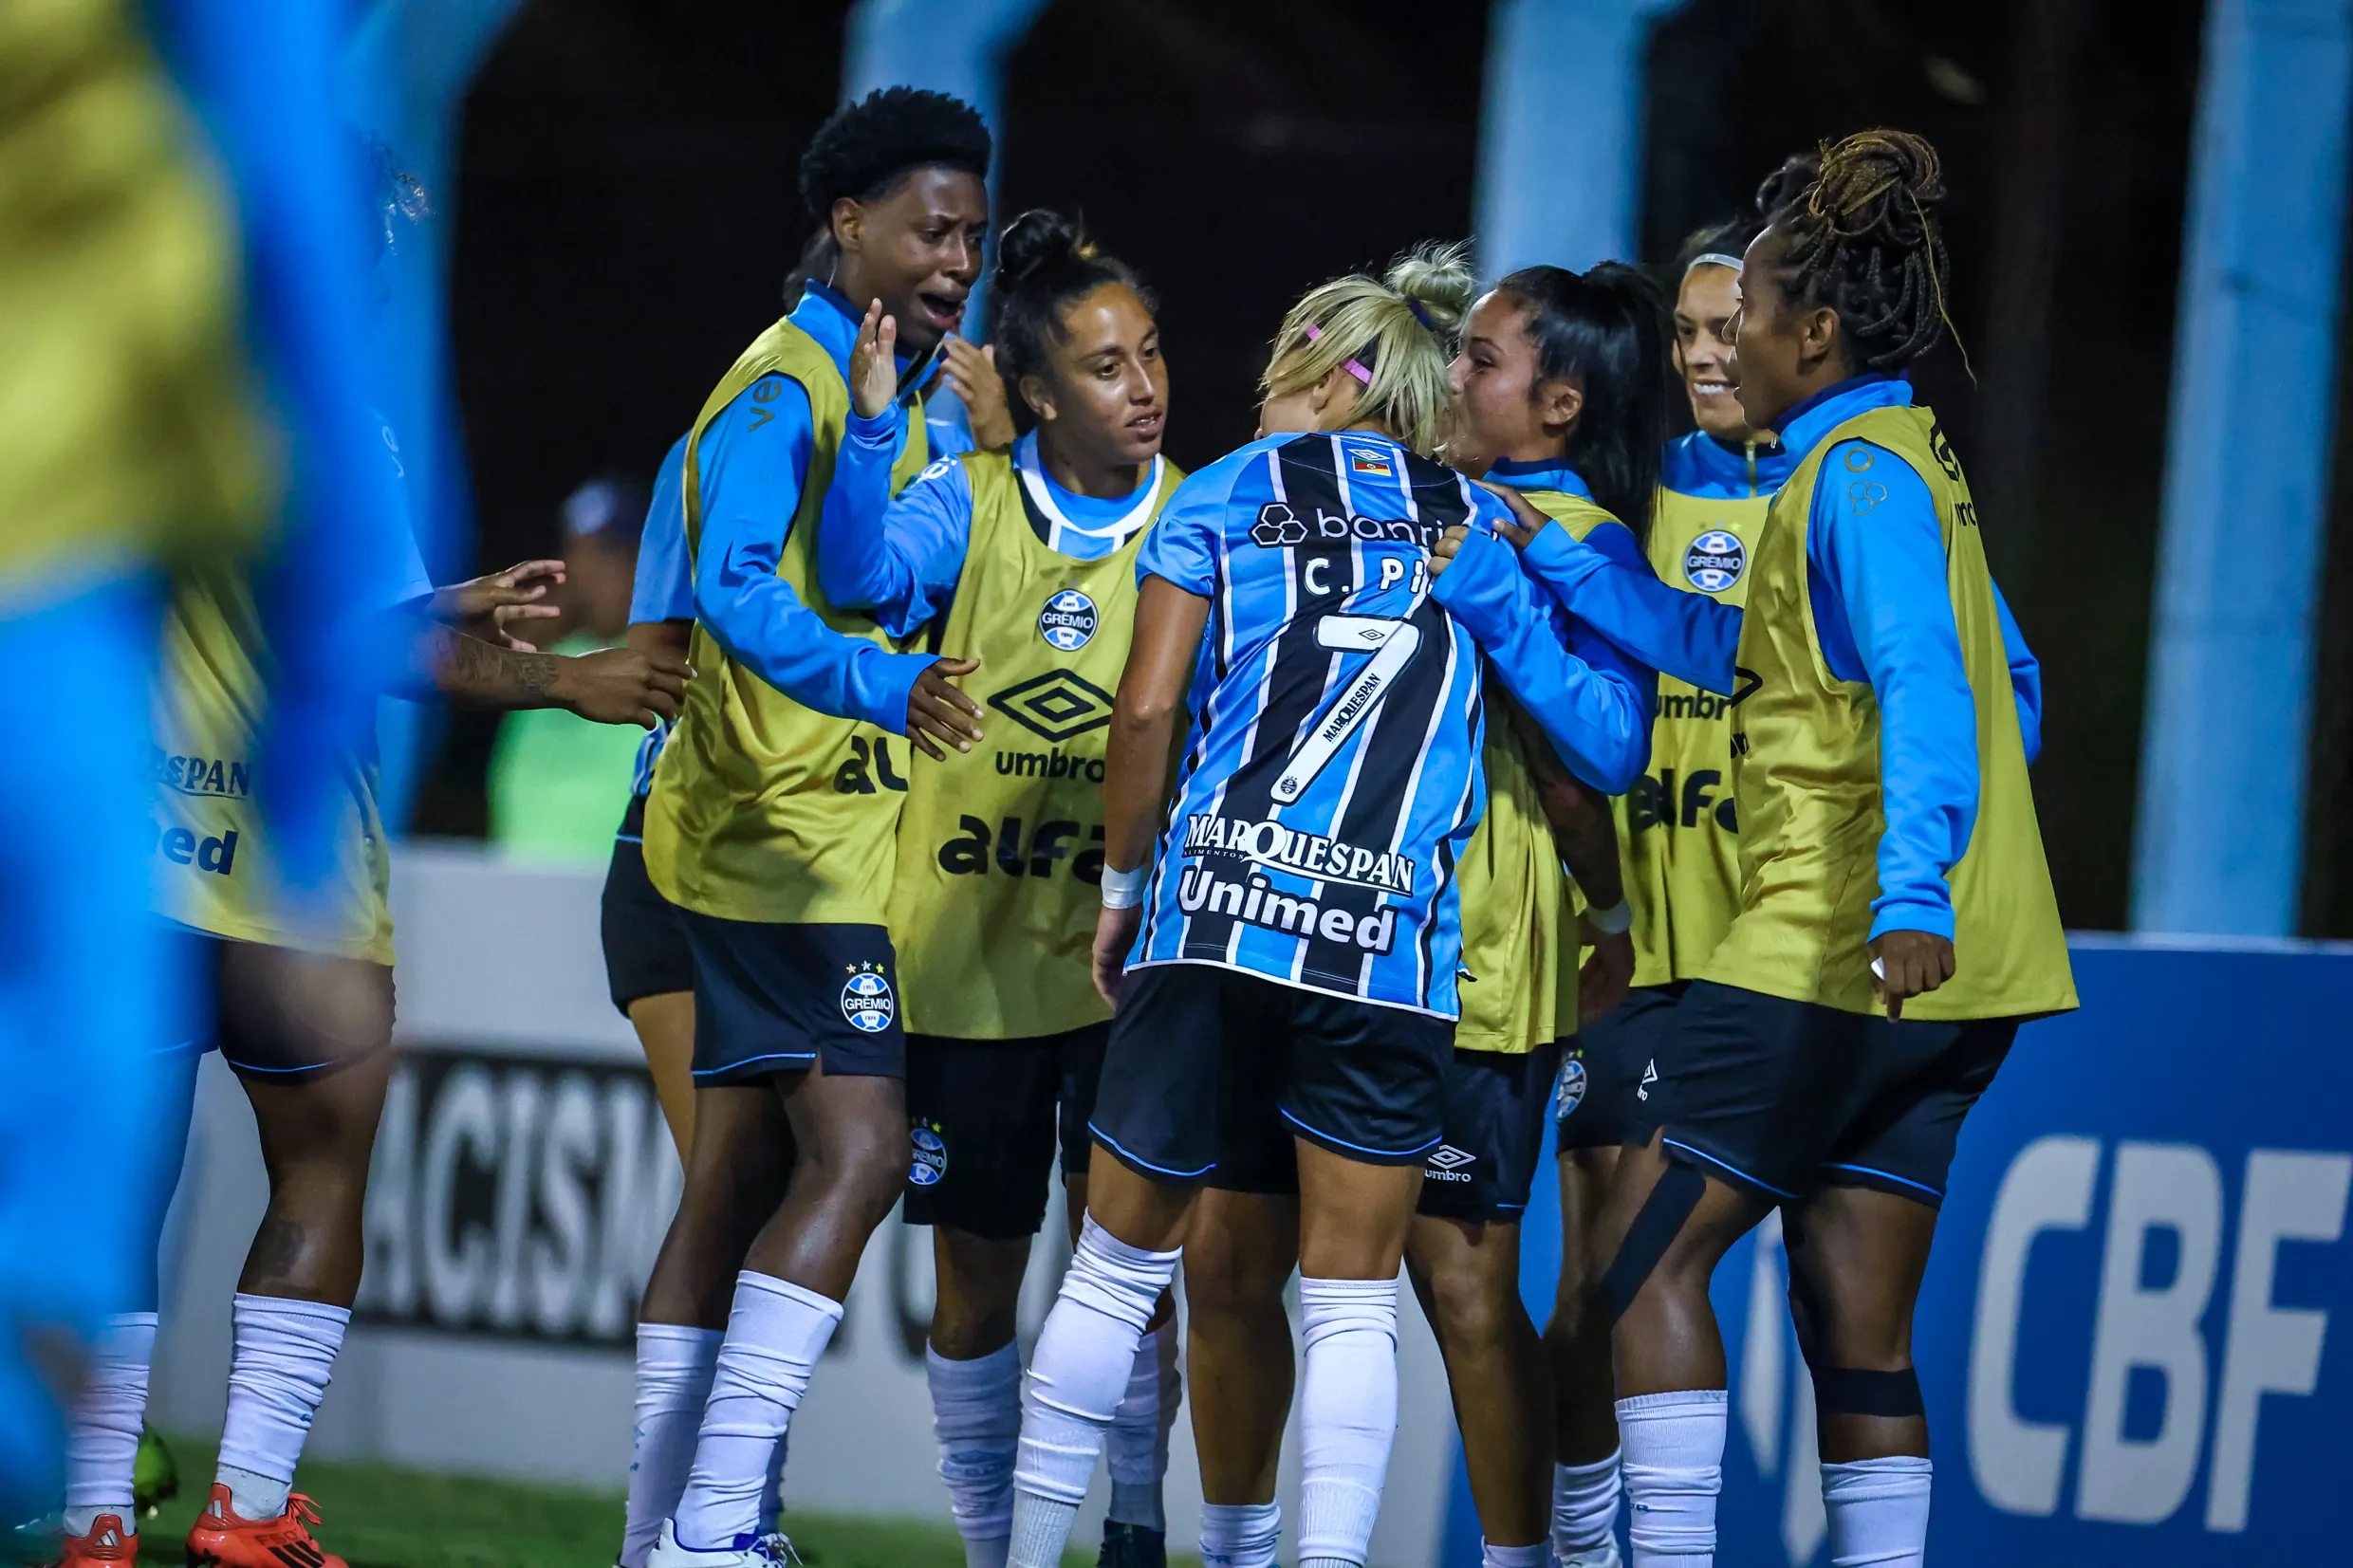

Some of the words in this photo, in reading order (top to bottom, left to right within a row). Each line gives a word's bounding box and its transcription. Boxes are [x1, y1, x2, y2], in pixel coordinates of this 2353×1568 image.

[1316, 507, 1444, 549] banri
[1380, 557, 1435, 595] PI
[1269, 615, 1420, 803] 7
[1322, 673, 1381, 743] MARQUESPAN
[996, 747, 1105, 784] umbro
[1184, 815, 1416, 896] MARQUESPAN
[1178, 868, 1396, 952] Unimed
[844, 994, 892, 1010] GRÊMIO
[1424, 1169, 1472, 1183] umbro
[1966, 1134, 2353, 1534] CBF
